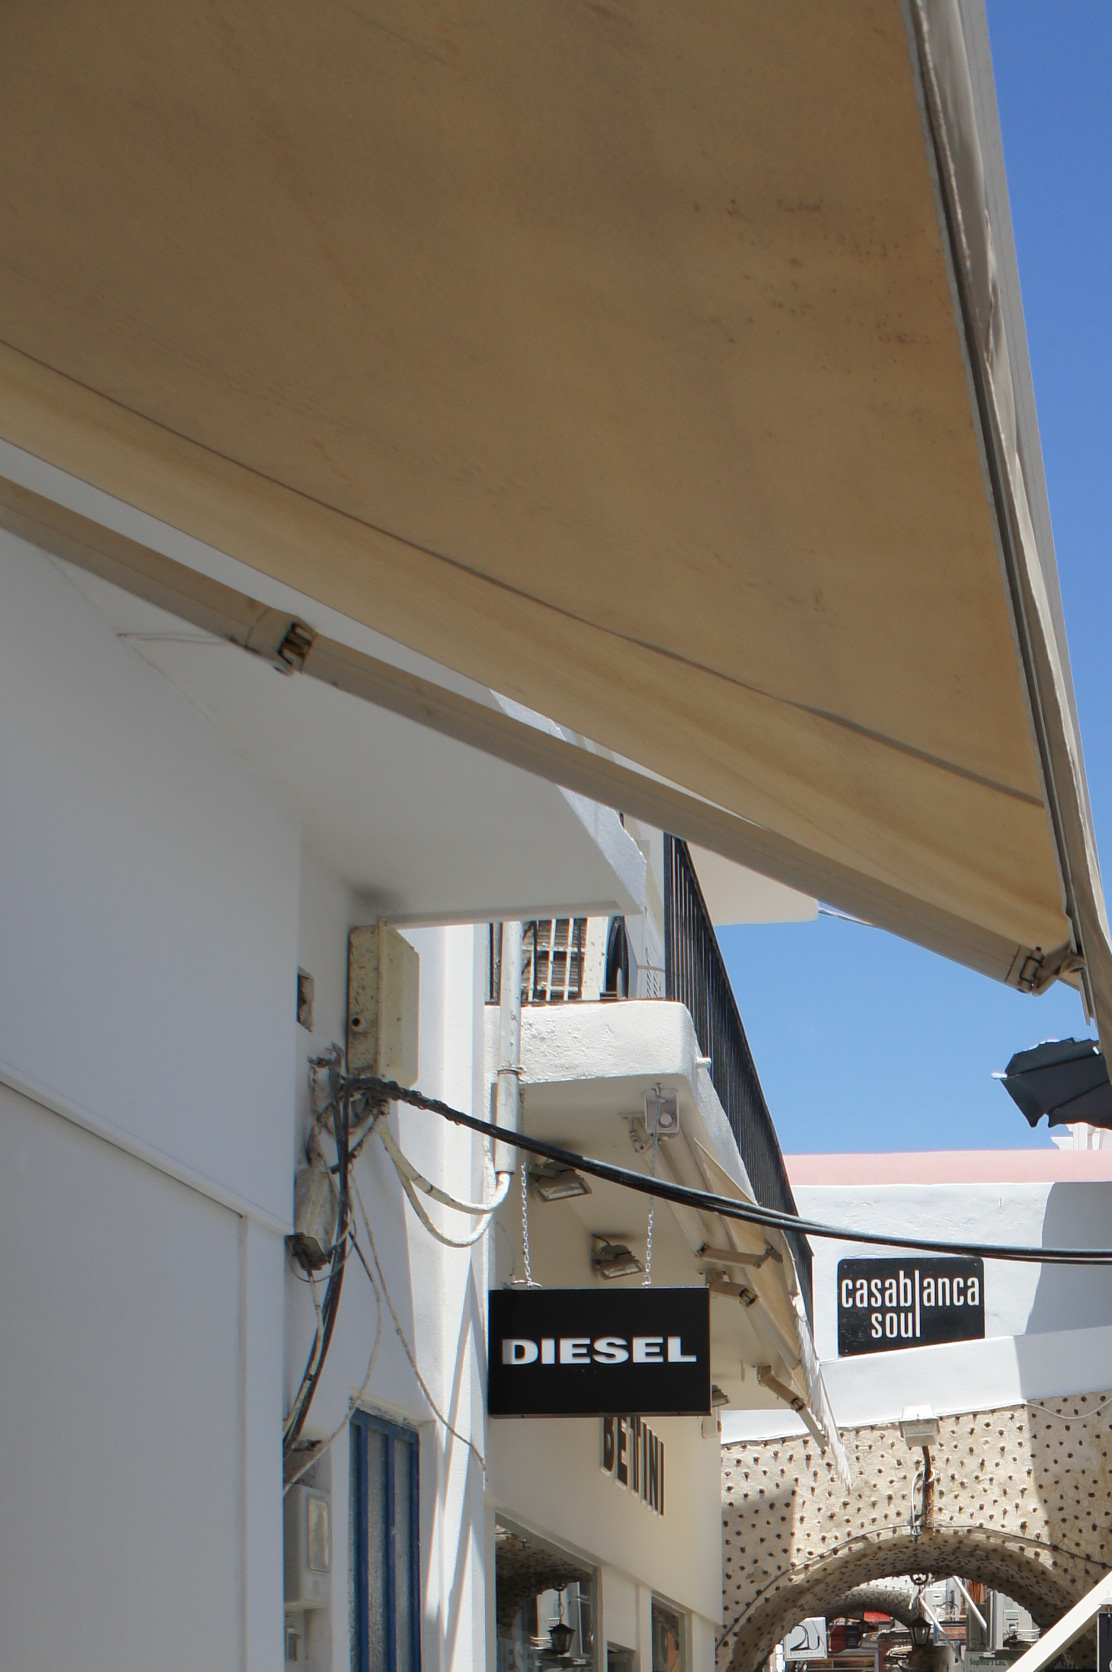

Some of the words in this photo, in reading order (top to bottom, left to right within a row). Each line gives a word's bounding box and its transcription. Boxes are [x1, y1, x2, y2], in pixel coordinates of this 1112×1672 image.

[841, 1269, 980, 1309] casablanca
[871, 1310, 921, 1338] soul
[501, 1336, 697, 1365] DIESEL
